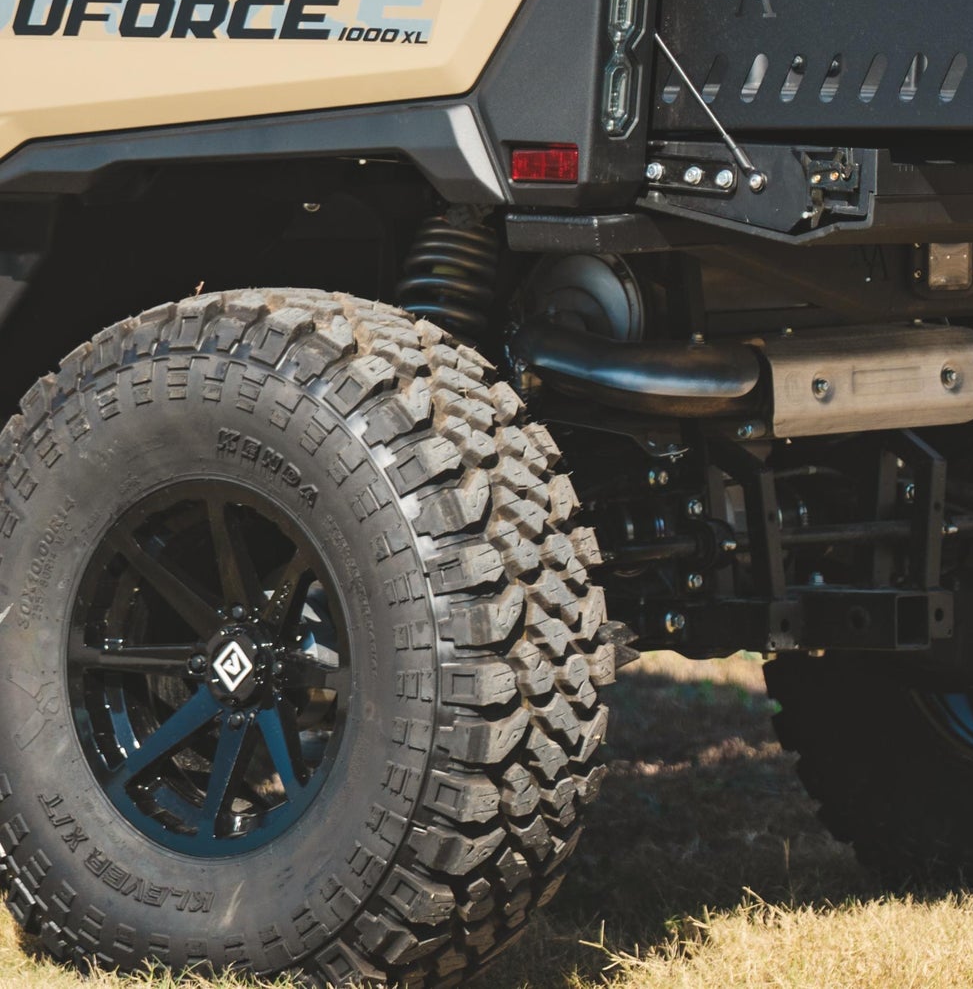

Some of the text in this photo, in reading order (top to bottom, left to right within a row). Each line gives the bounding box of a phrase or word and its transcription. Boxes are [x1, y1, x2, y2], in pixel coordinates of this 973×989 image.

[338, 27, 400, 43] 1000
[401, 31, 428, 44] XL
[216, 427, 319, 509] KENDA
[38, 792, 90, 853] X/T
[83, 847, 216, 913] KLEVER
